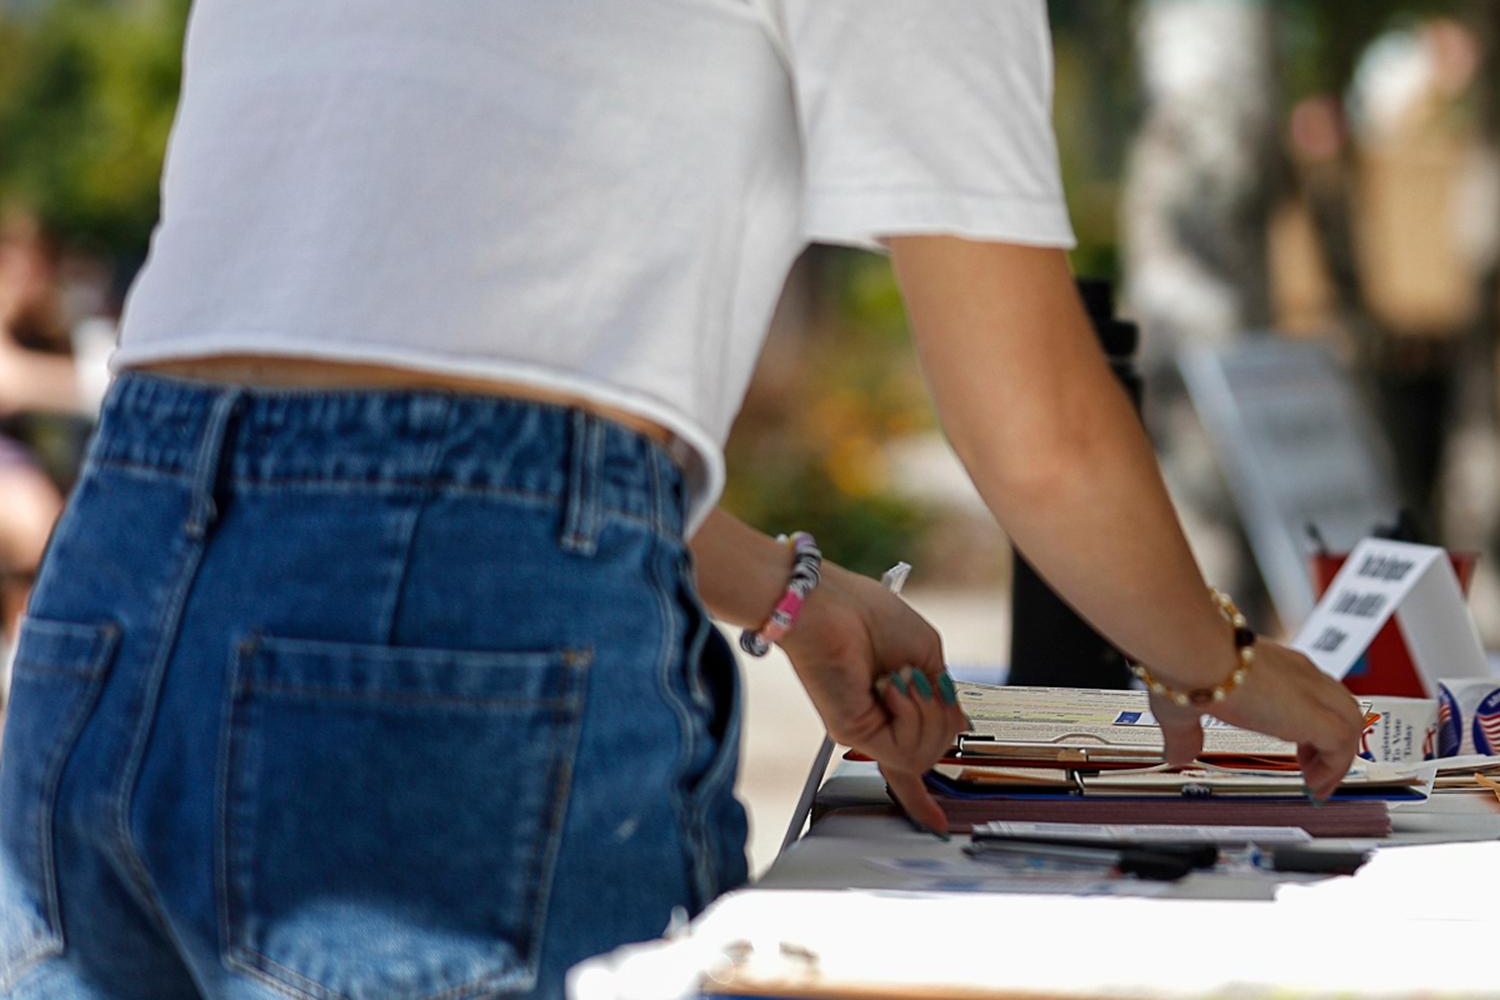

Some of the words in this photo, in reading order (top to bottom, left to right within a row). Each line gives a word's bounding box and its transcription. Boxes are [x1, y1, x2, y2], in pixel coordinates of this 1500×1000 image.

[1392, 718, 1401, 744] Vote
[1403, 725, 1413, 758] Today
[1392, 747, 1401, 761] To
